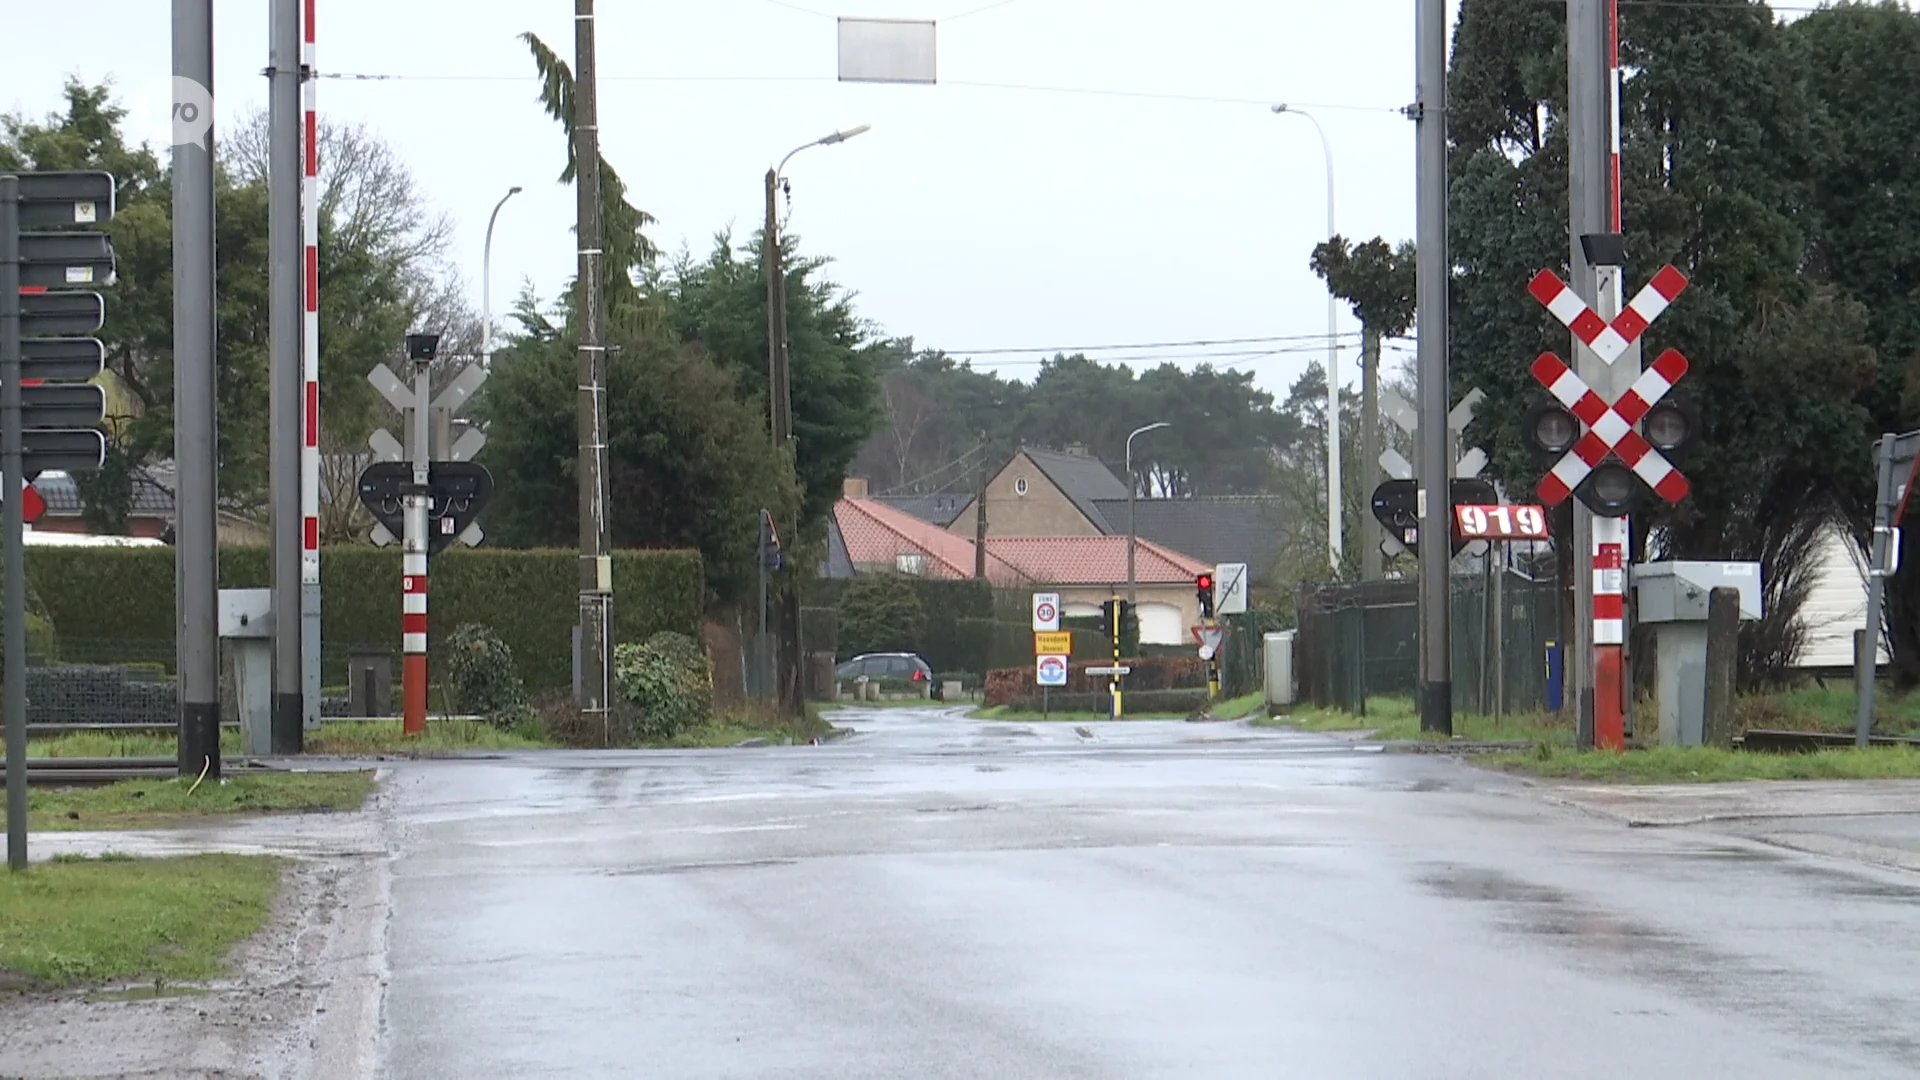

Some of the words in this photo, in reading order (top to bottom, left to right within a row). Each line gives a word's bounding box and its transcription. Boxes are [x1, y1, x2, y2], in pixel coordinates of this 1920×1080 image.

[1461, 506, 1543, 534] 919
[1222, 581, 1240, 595] 50
[1040, 608, 1052, 617] 30
